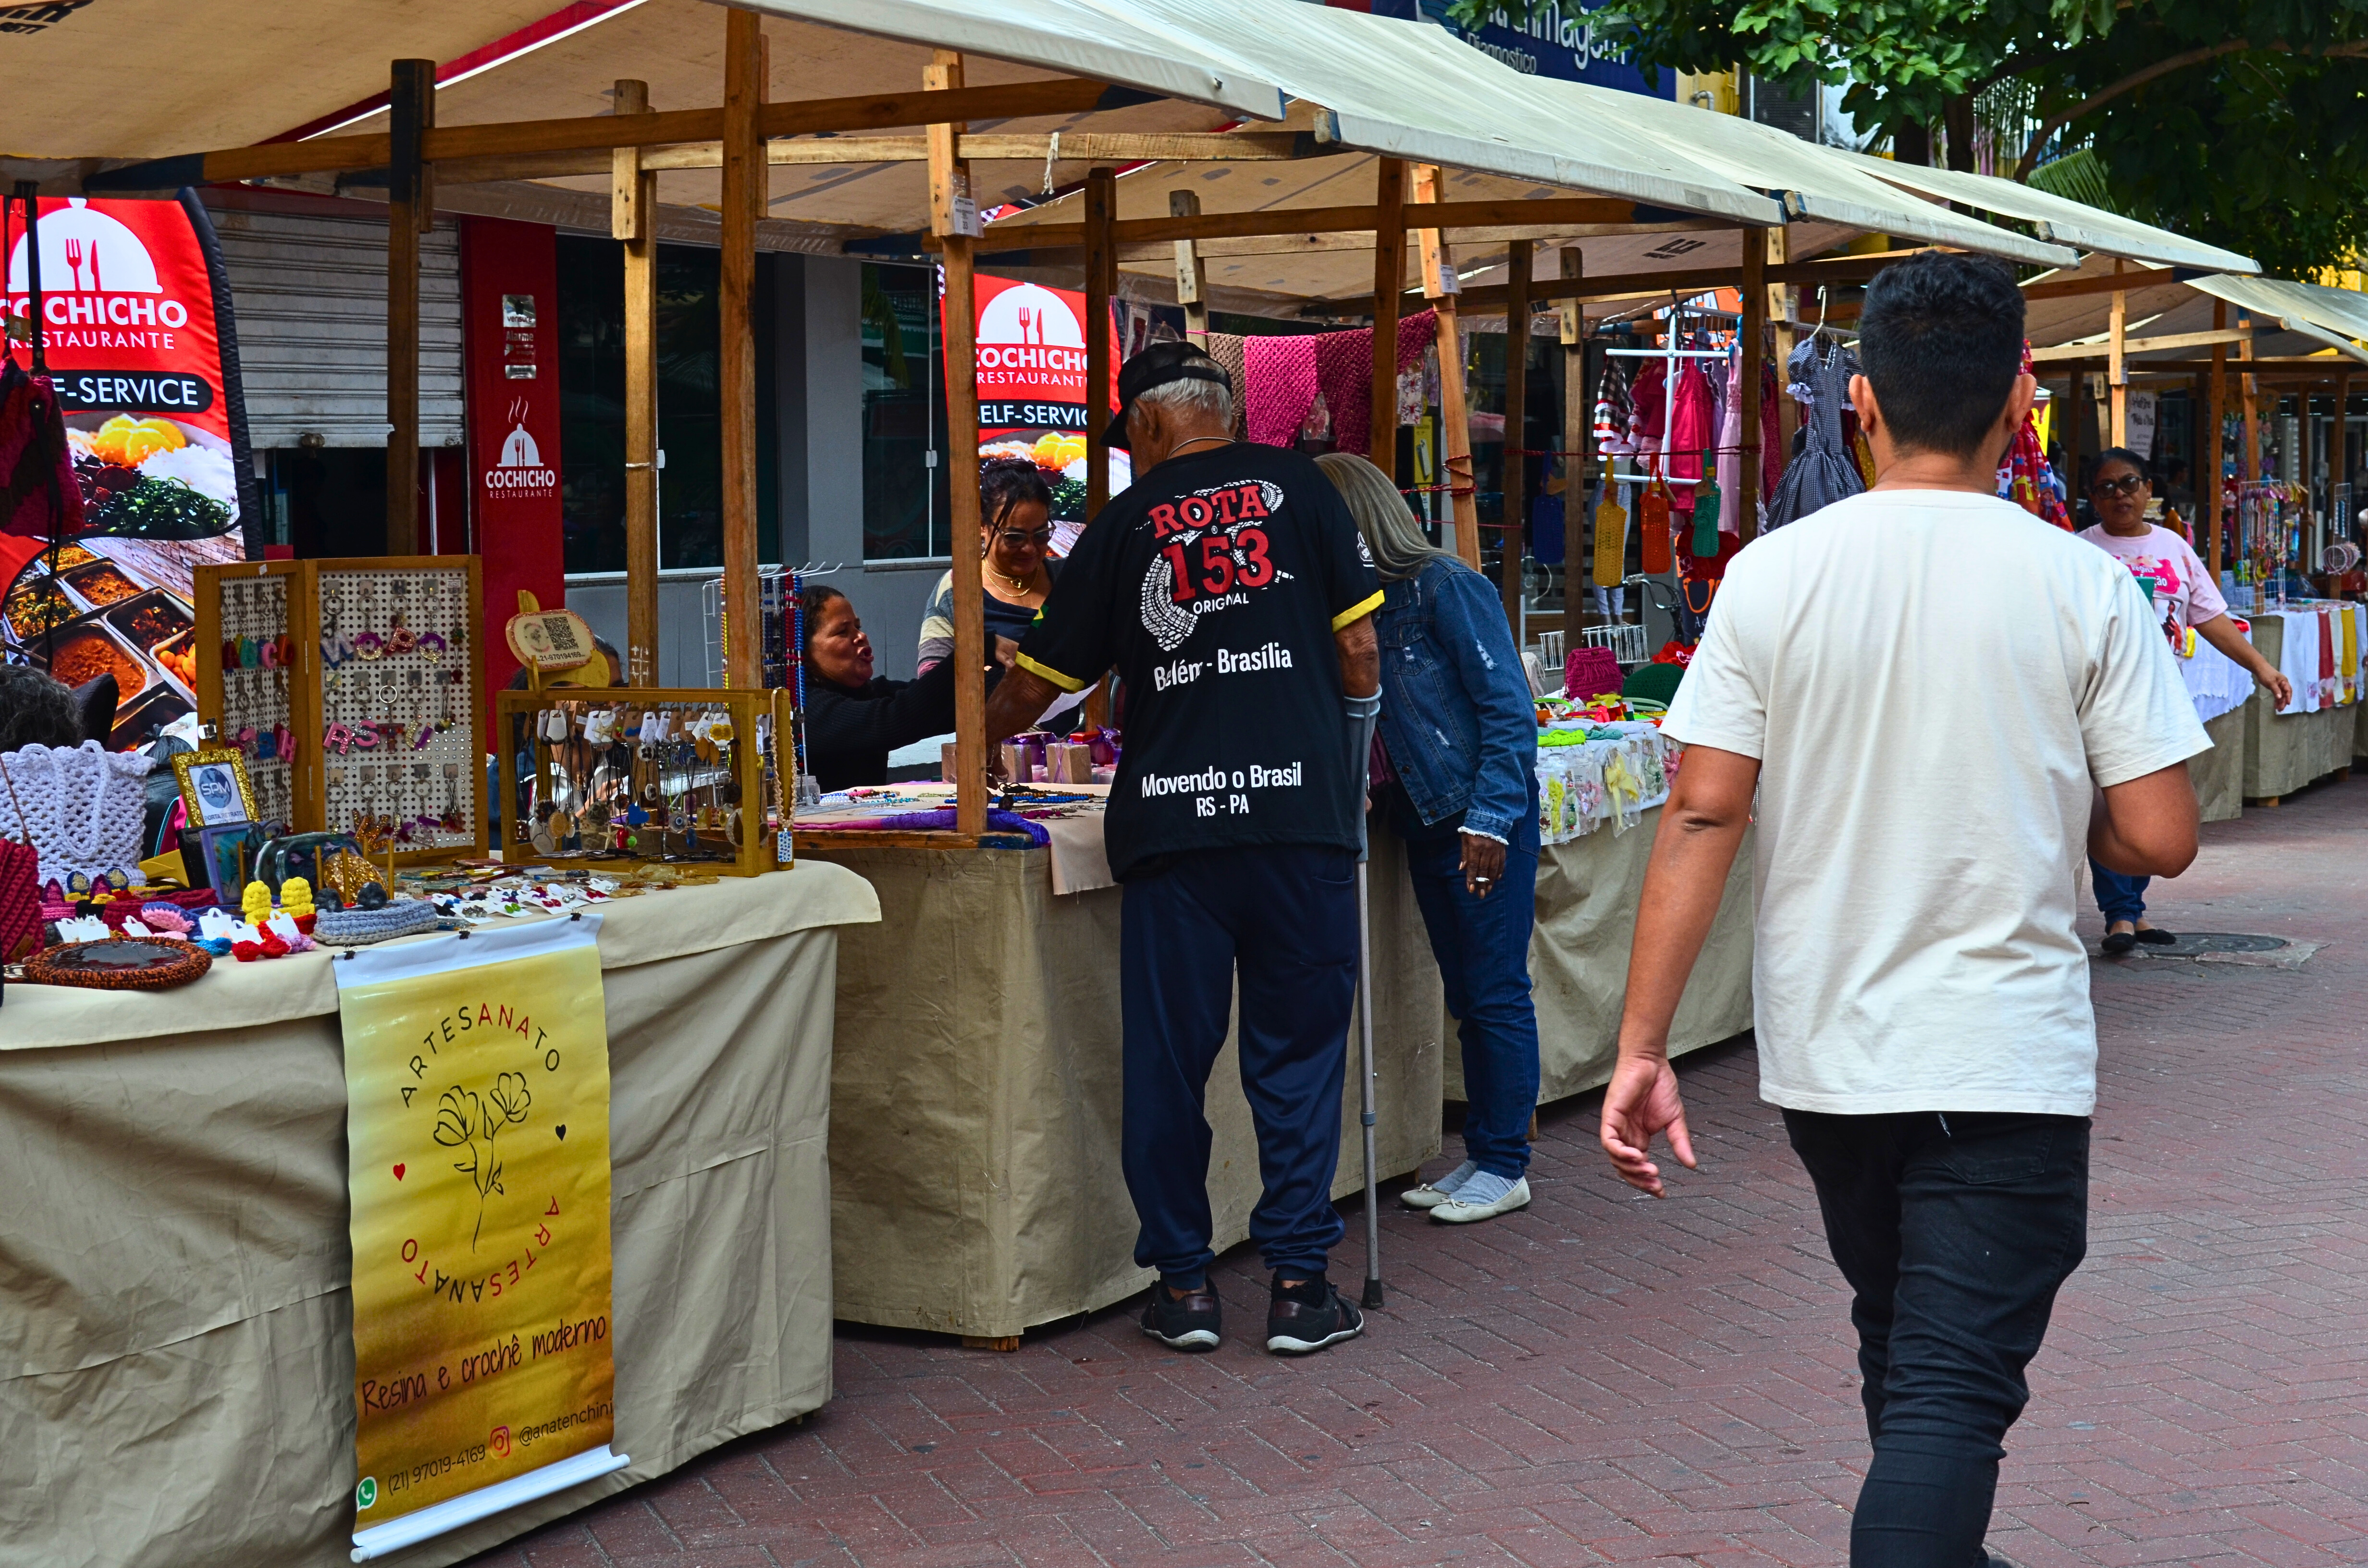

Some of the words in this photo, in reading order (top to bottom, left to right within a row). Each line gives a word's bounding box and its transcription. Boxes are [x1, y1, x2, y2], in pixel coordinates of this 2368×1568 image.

[506, 331, 534, 342] Alarme
[976, 347, 1087, 371] OCHICH
[486, 470, 555, 489] COCHICHO
[490, 489, 552, 498] RESTAURANTE
[1148, 485, 1269, 539] ROTA
[1163, 529, 1273, 602] 153
[1154, 659, 1203, 691] Belém
[1218, 642, 1293, 674] Brasília
[201, 781, 230, 796] SPM
[1142, 766, 1226, 798] Movendo
[1232, 771, 1245, 788] o
[1250, 761, 1301, 788] Brasil
[1196, 796, 1216, 817] RS
[1230, 794, 1249, 814] PA
[402, 1003, 560, 1108] ARTESANATO
[401, 1195, 559, 1303] ARTESANATO
[362, 1371, 427, 1416] Resina
[438, 1366, 450, 1390] e
[462, 1334, 522, 1383] crochê
[532, 1316, 606, 1360] moderno
[388, 1470, 409, 1496] (21)
[413, 1444, 485, 1483] 97019-4169
